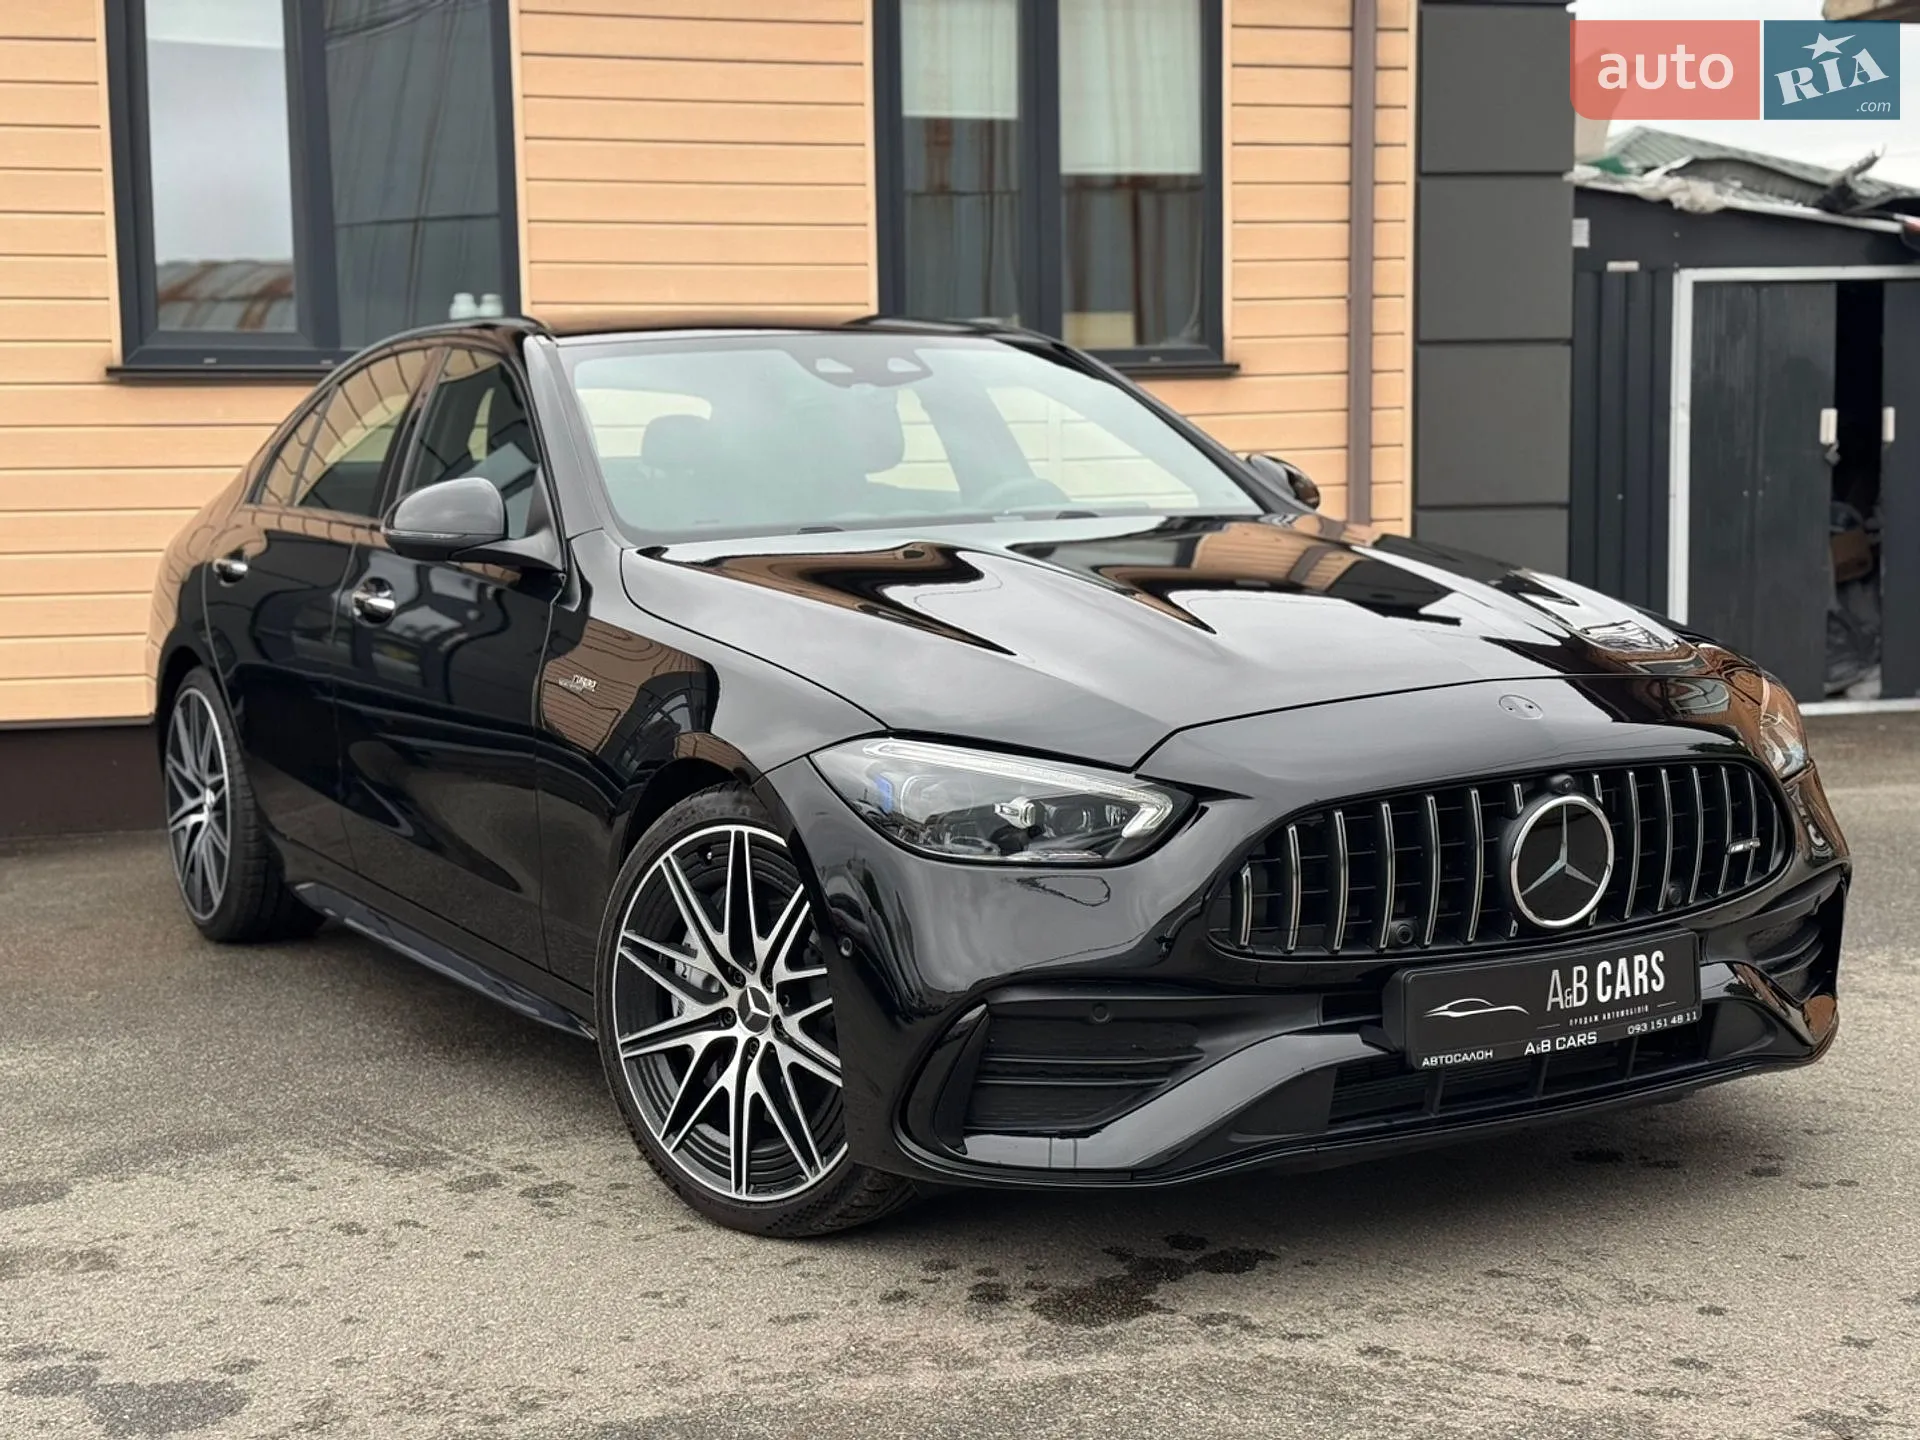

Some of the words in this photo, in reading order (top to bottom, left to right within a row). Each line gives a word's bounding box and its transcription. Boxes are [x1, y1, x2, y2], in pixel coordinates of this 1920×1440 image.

[1546, 965, 1588, 1011] A&B
[1597, 950, 1665, 1003] CARS
[1627, 1022, 1648, 1035] 093
[1651, 1018, 1668, 1030] 151
[1686, 1011, 1697, 1021] 11
[1555, 1031, 1597, 1050] CARS
[1421, 1049, 1494, 1067] АВТОСАЛОН
